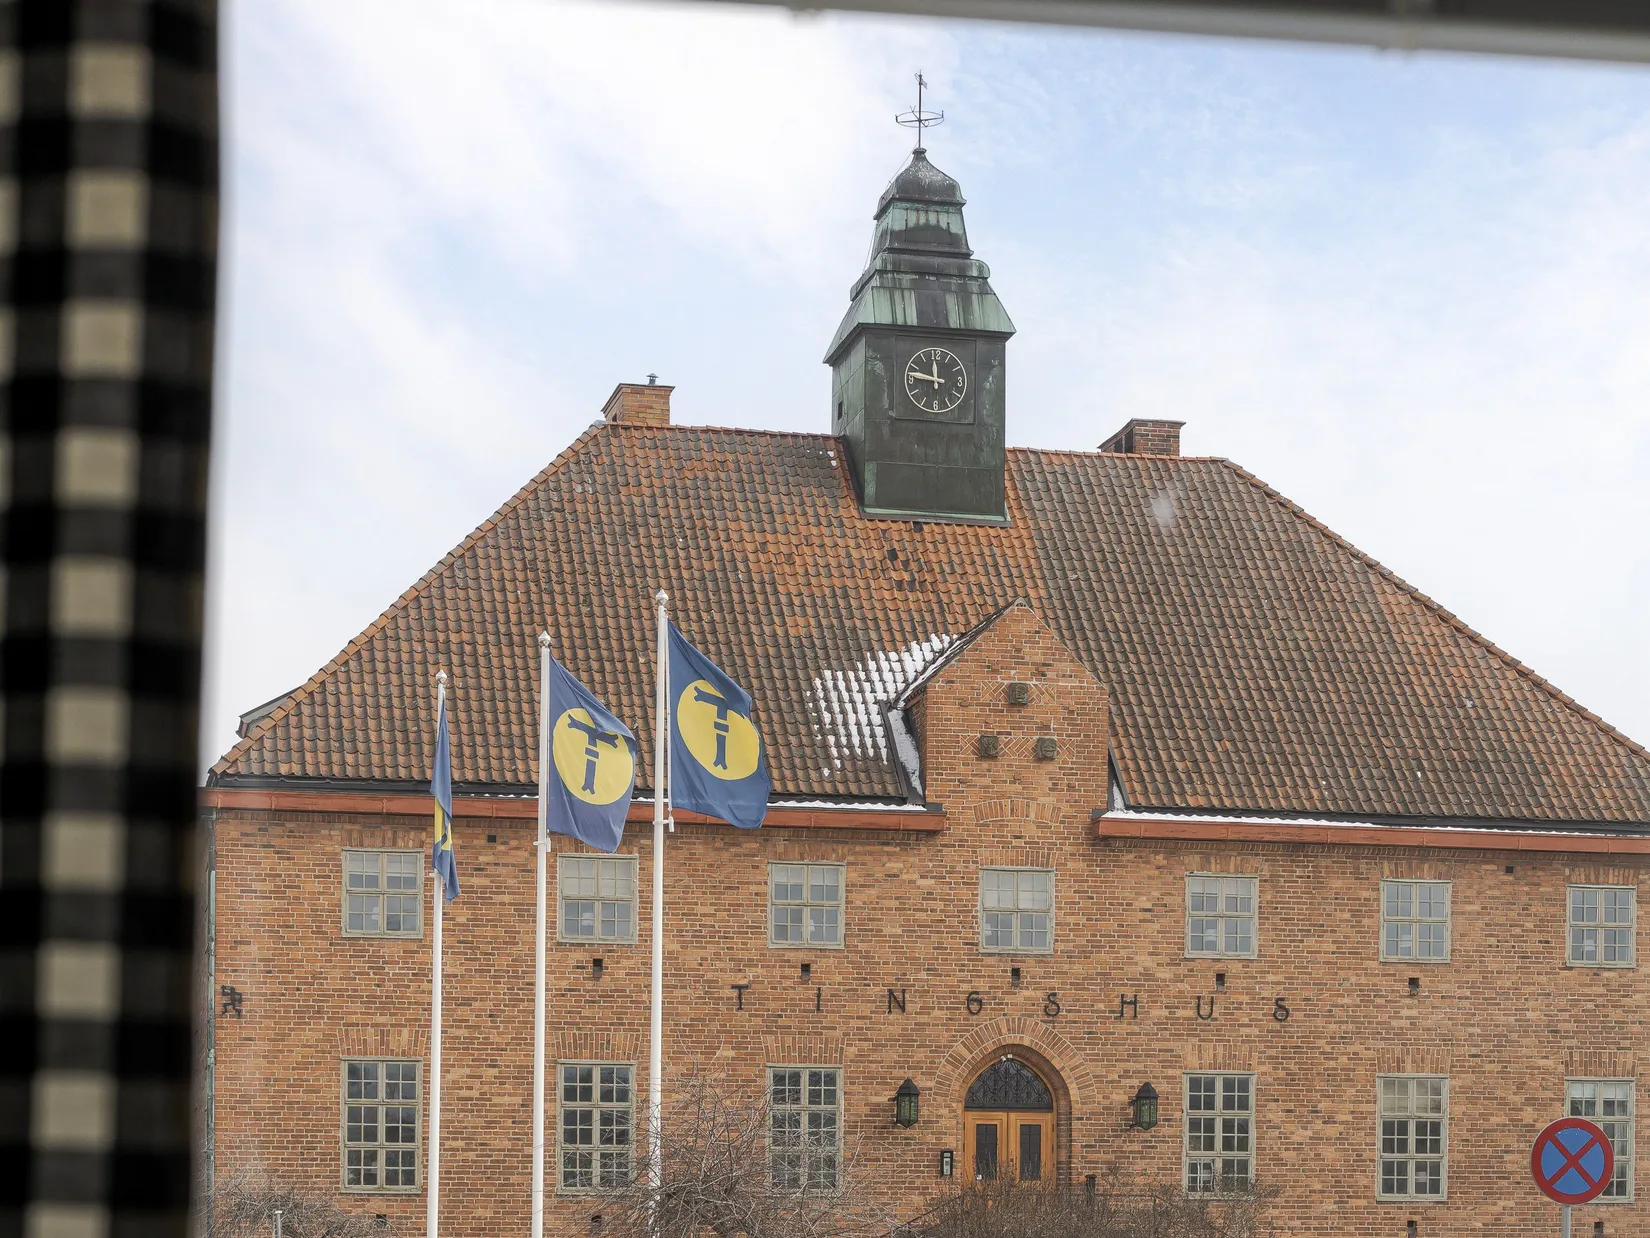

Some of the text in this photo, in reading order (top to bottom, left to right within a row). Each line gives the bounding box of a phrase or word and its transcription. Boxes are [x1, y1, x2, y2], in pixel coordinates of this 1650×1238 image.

[931, 350, 941, 360] 12
[908, 375, 963, 387] 9 3
[933, 400, 939, 411] 6
[731, 984, 1290, 1023] TINGSHUS
